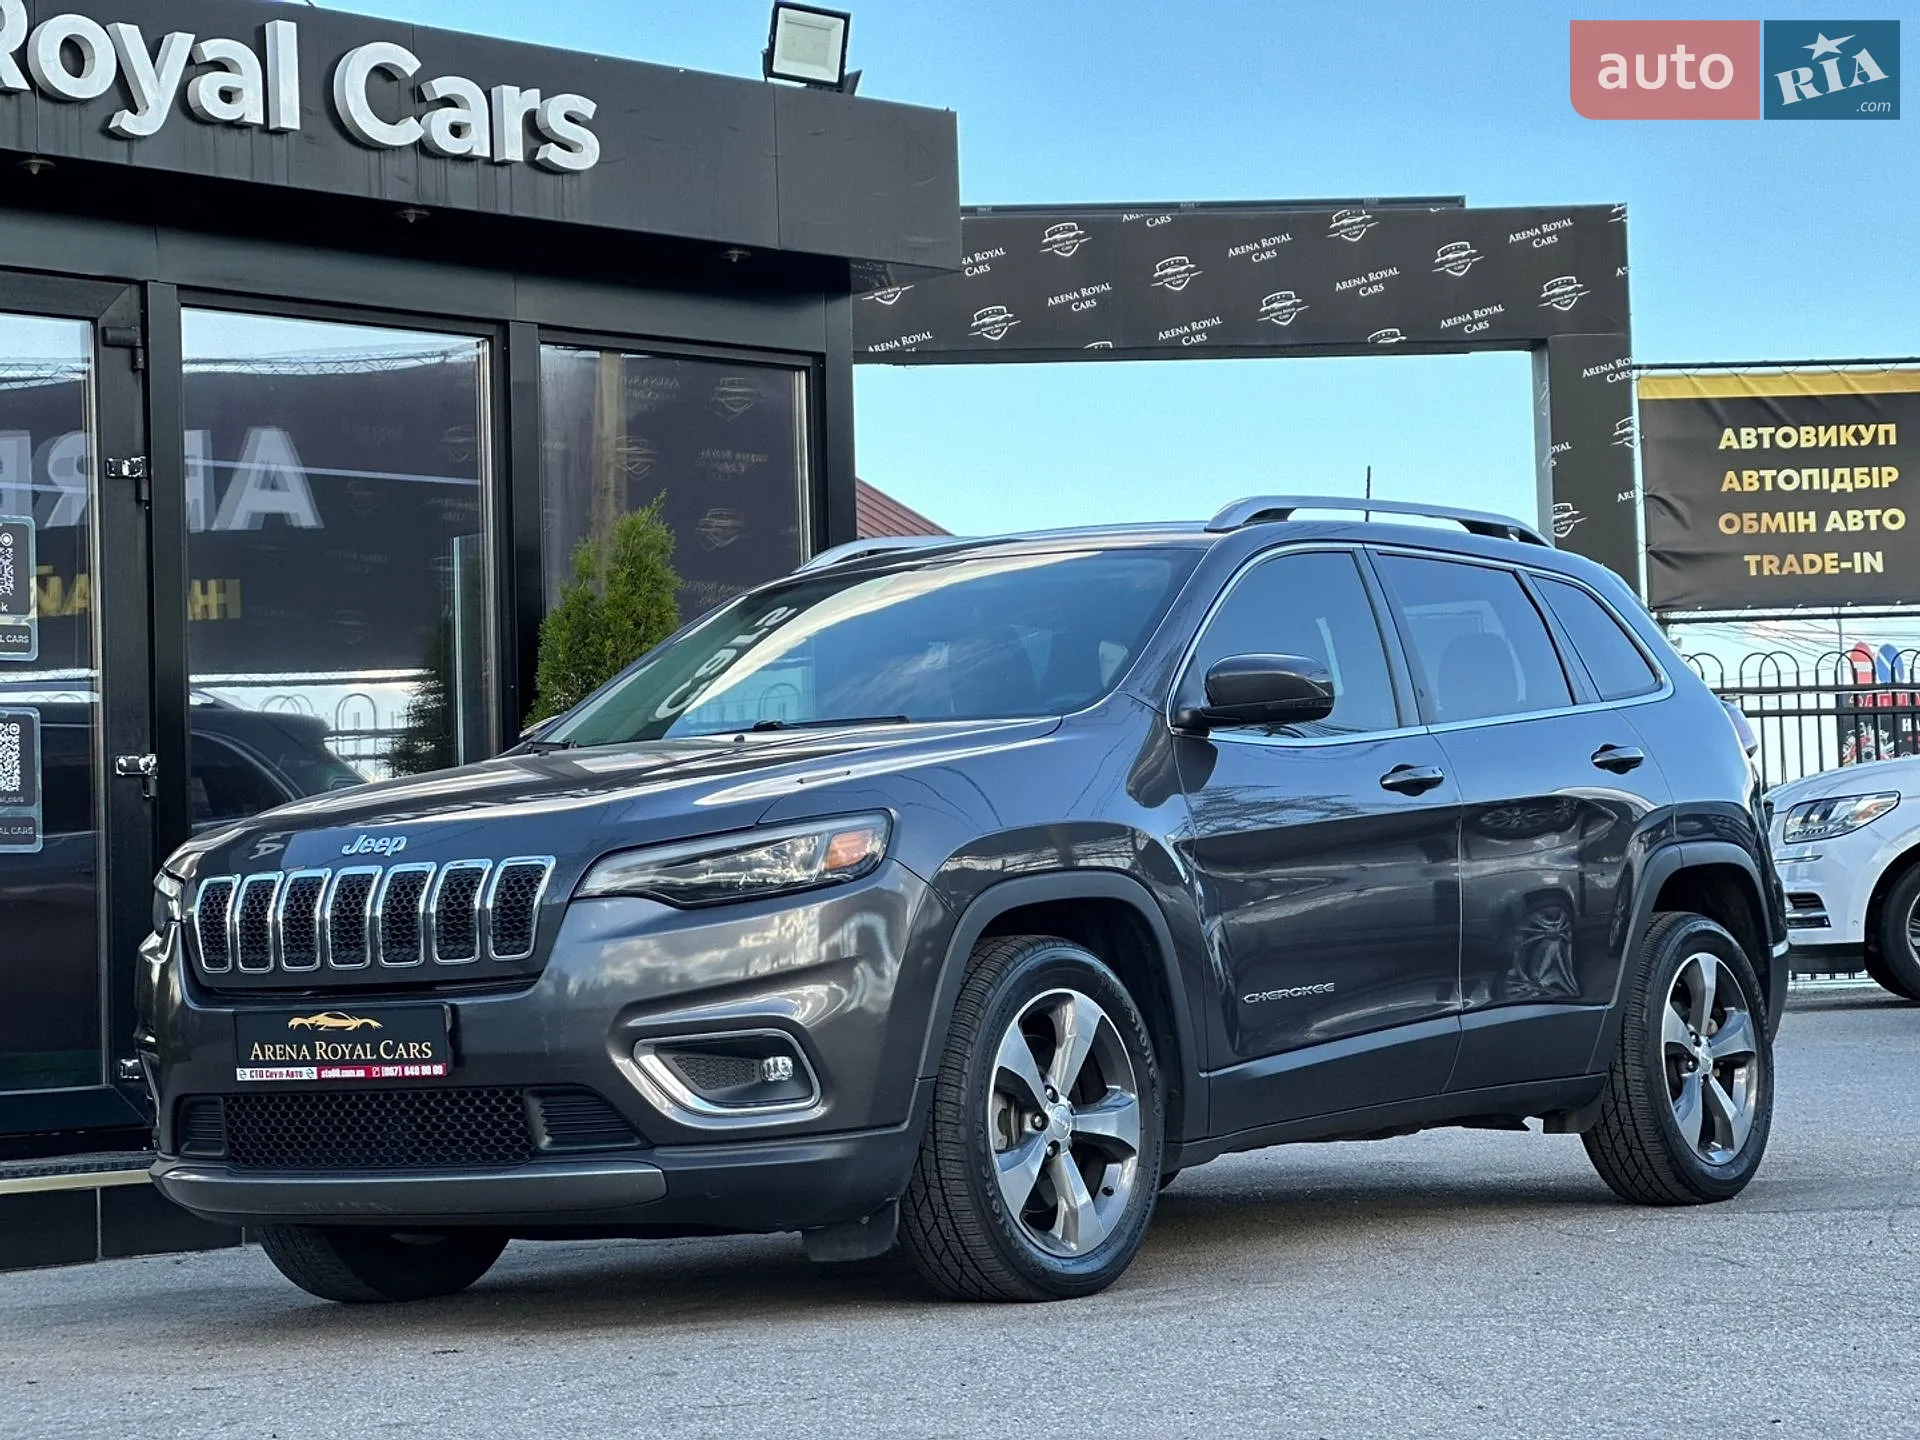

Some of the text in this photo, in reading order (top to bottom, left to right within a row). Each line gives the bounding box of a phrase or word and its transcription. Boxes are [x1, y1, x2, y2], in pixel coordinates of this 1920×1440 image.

[333, 41, 600, 173] Cars
[1146, 214, 1172, 227] CARS
[1510, 218, 1574, 244] ARENA ROYAL
[1228, 233, 1293, 258] ARENA ROYAL
[1531, 234, 1558, 248] CARS
[974, 247, 1006, 264] ROYAL
[1251, 249, 1277, 263] CARS
[964, 263, 991, 277] CARS
[1335, 267, 1400, 292] ARENA ROYAL
[1047, 282, 1113, 307] ARENA ROYAL
[1358, 283, 1385, 297] CARS
[1071, 299, 1097, 312] CARS
[1440, 303, 1505, 330] ARENA ROYAL
[1158, 316, 1223, 341] ARENA ROYAL
[1463, 320, 1489, 334] CARS
[901, 331, 933, 346] ROYAL
[1181, 332, 1208, 346] CARS
[1582, 362, 1615, 379] ARENA
[1718, 423, 1897, 450] АВТОВИКУП
[1721, 466, 1899, 493] АВТОПІДБІР
[1718, 508, 1906, 535] ОБМІН АВТО
[1744, 551, 1884, 576] TRADE-IN
[341, 834, 407, 857] Jeep
[1243, 982, 1335, 1004] CHEROKEE
[250, 1039, 432, 1060] ARENA ROYAL CARS
